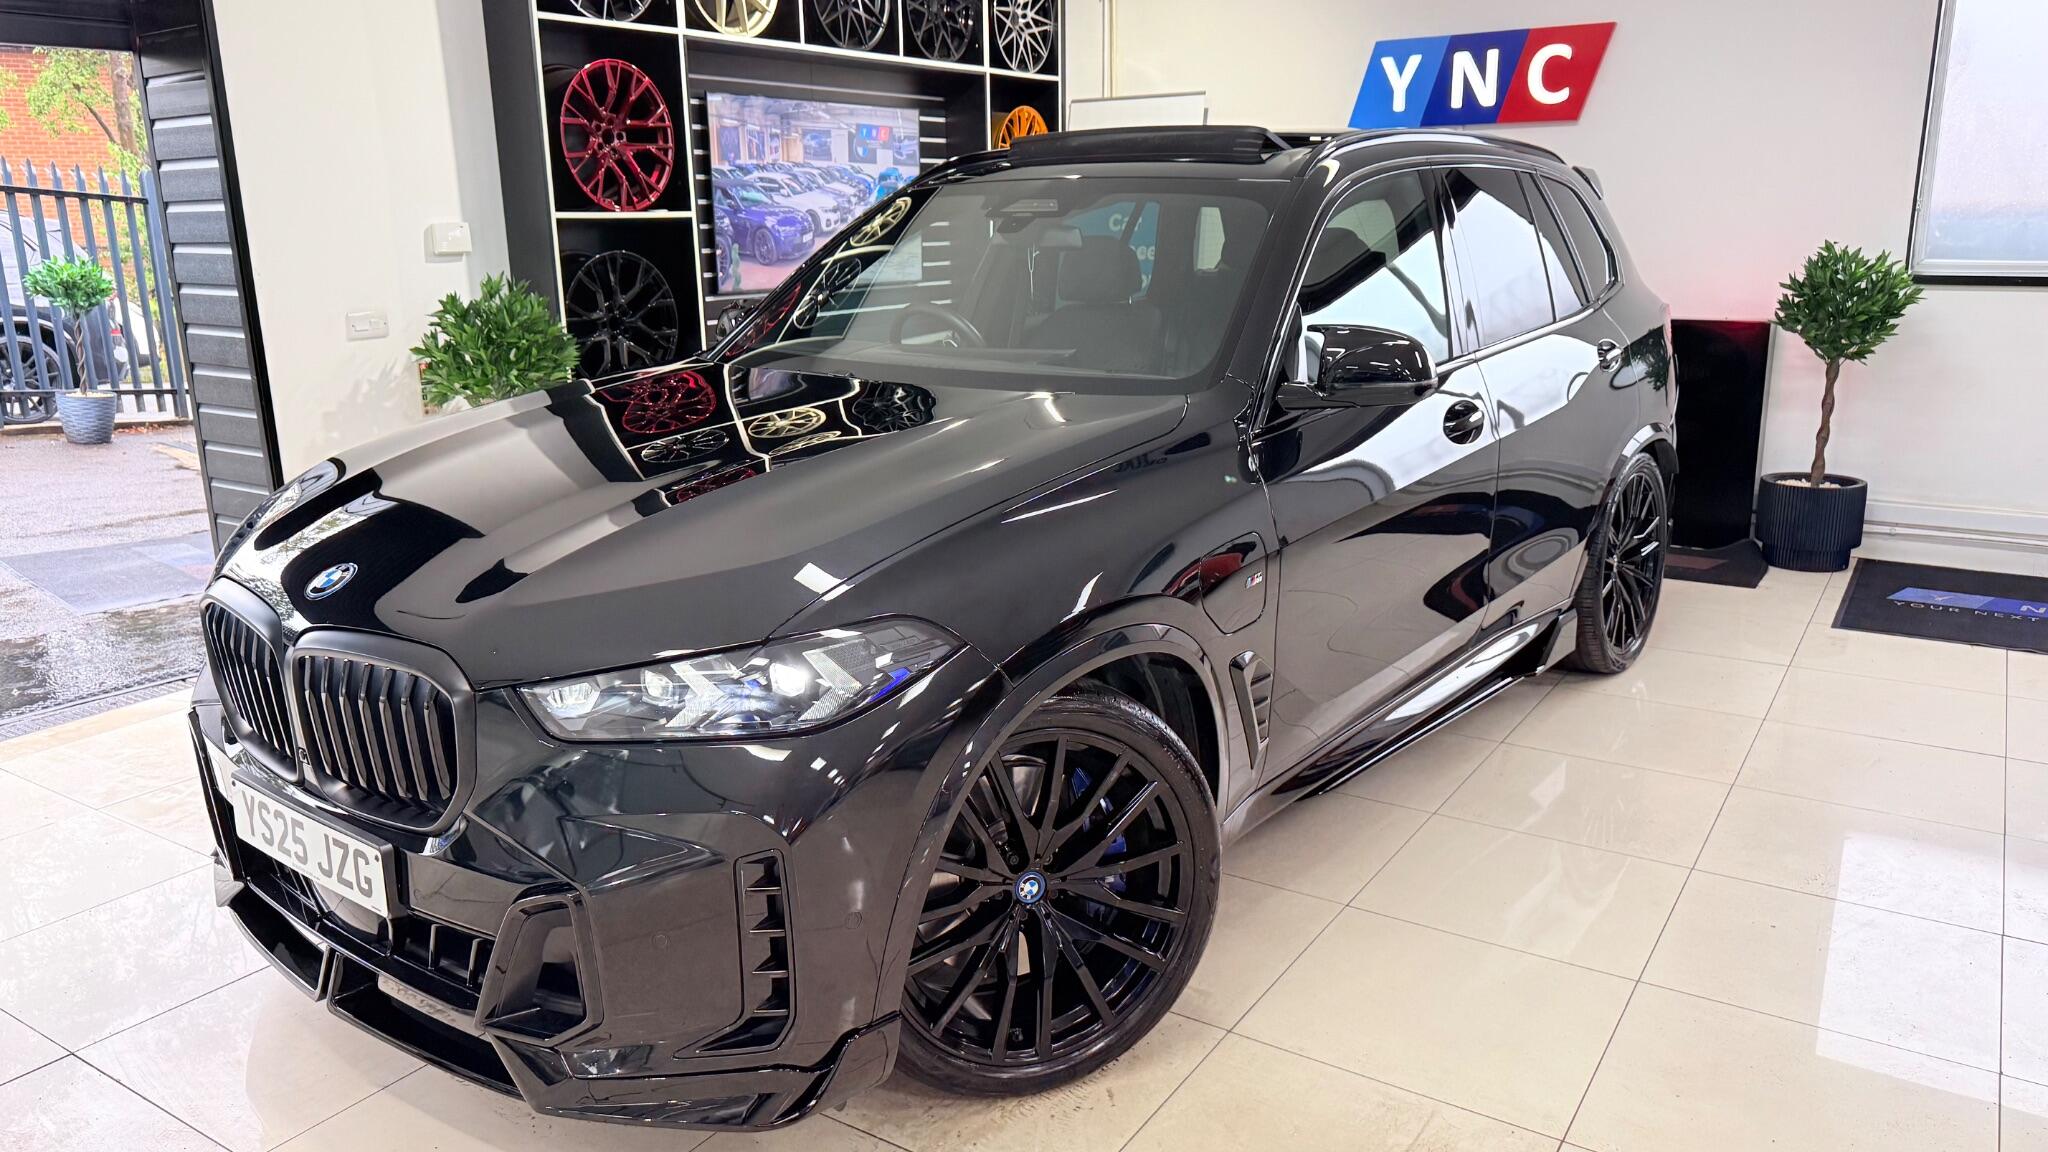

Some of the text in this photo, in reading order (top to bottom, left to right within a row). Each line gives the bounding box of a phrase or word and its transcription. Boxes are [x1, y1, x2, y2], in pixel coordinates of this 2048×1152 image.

[1380, 43, 1573, 113] YNC
[1893, 600, 2040, 622] YOUR NEXT
[241, 790, 373, 899] YS25 JZG
